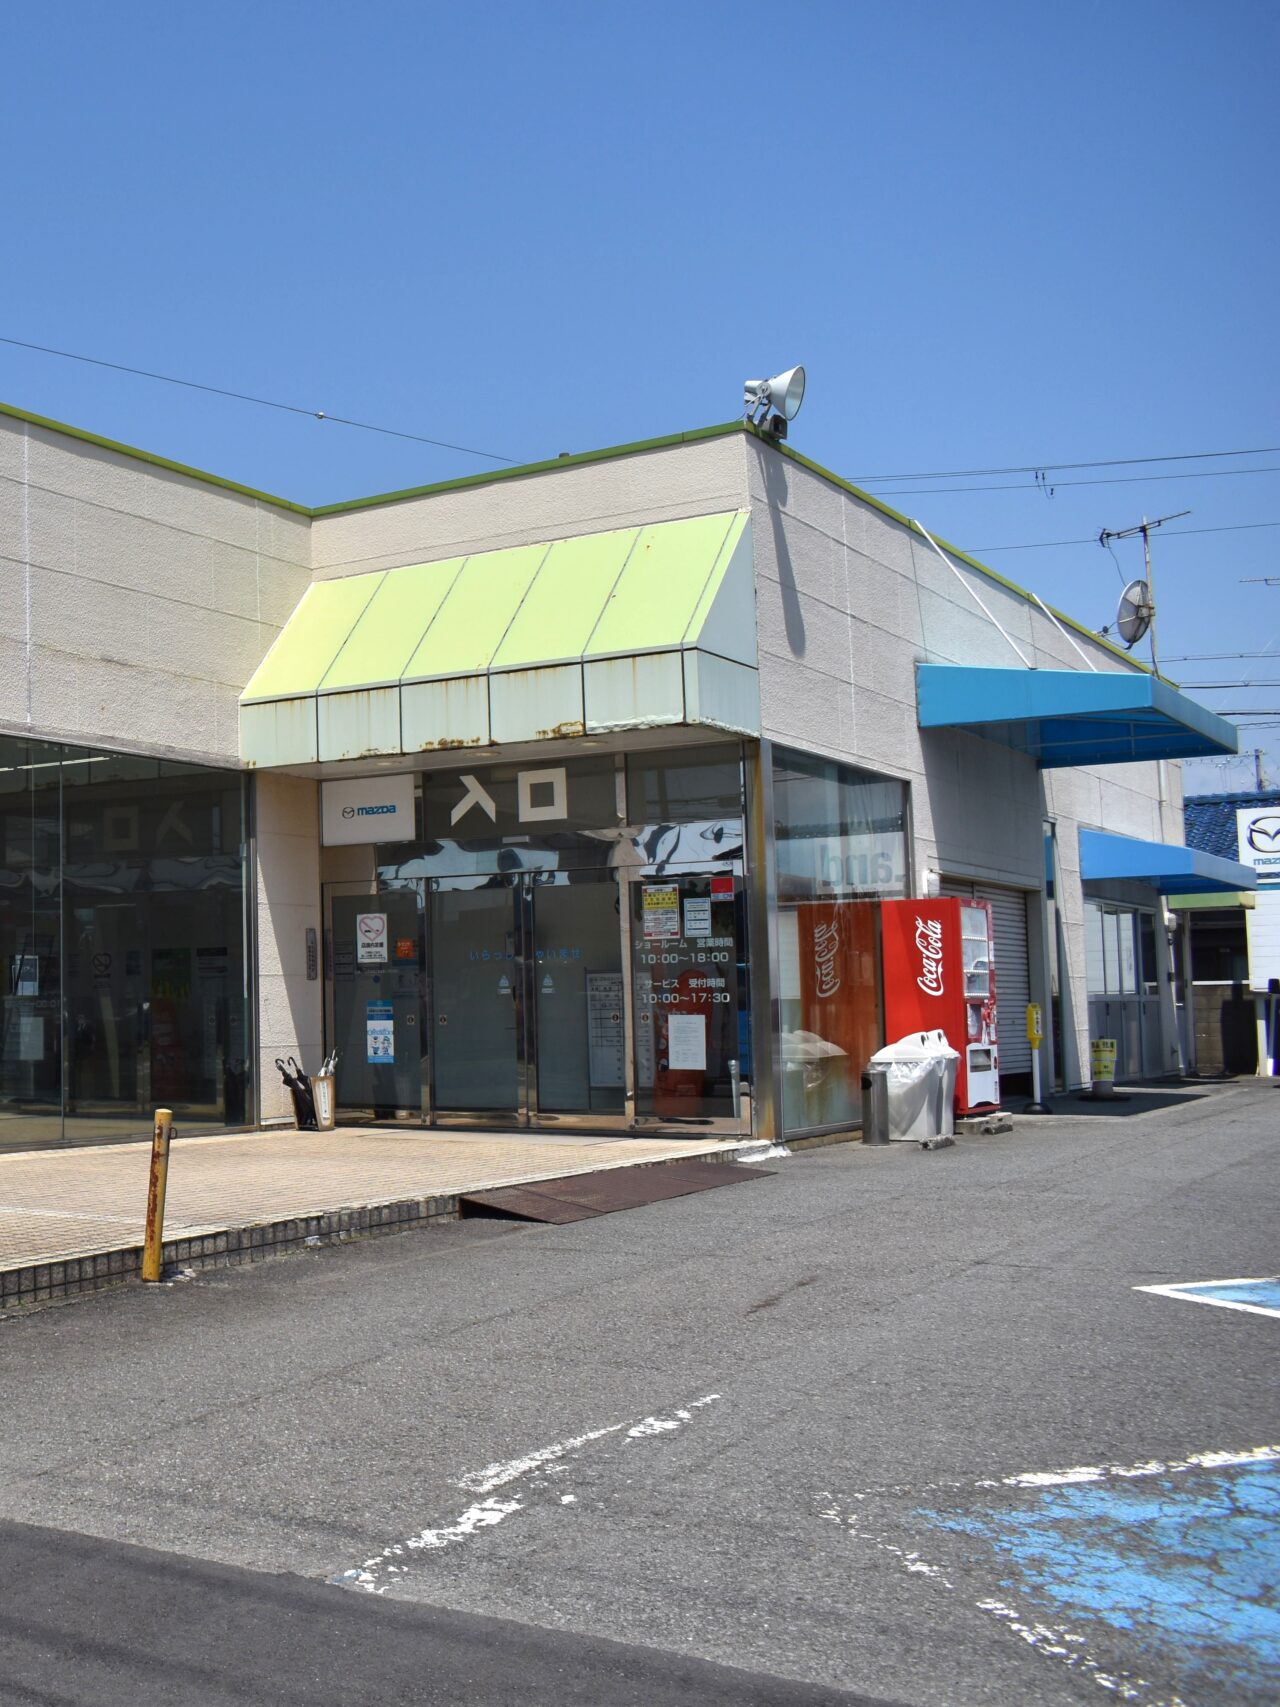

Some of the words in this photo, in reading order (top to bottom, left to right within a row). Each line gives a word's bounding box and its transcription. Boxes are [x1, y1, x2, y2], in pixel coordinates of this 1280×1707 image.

[451, 767, 568, 826] 入口
[635, 940, 688, 950] ショールーム
[644, 979, 680, 989] サービス
[688, 977, 726, 988] 受付時間
